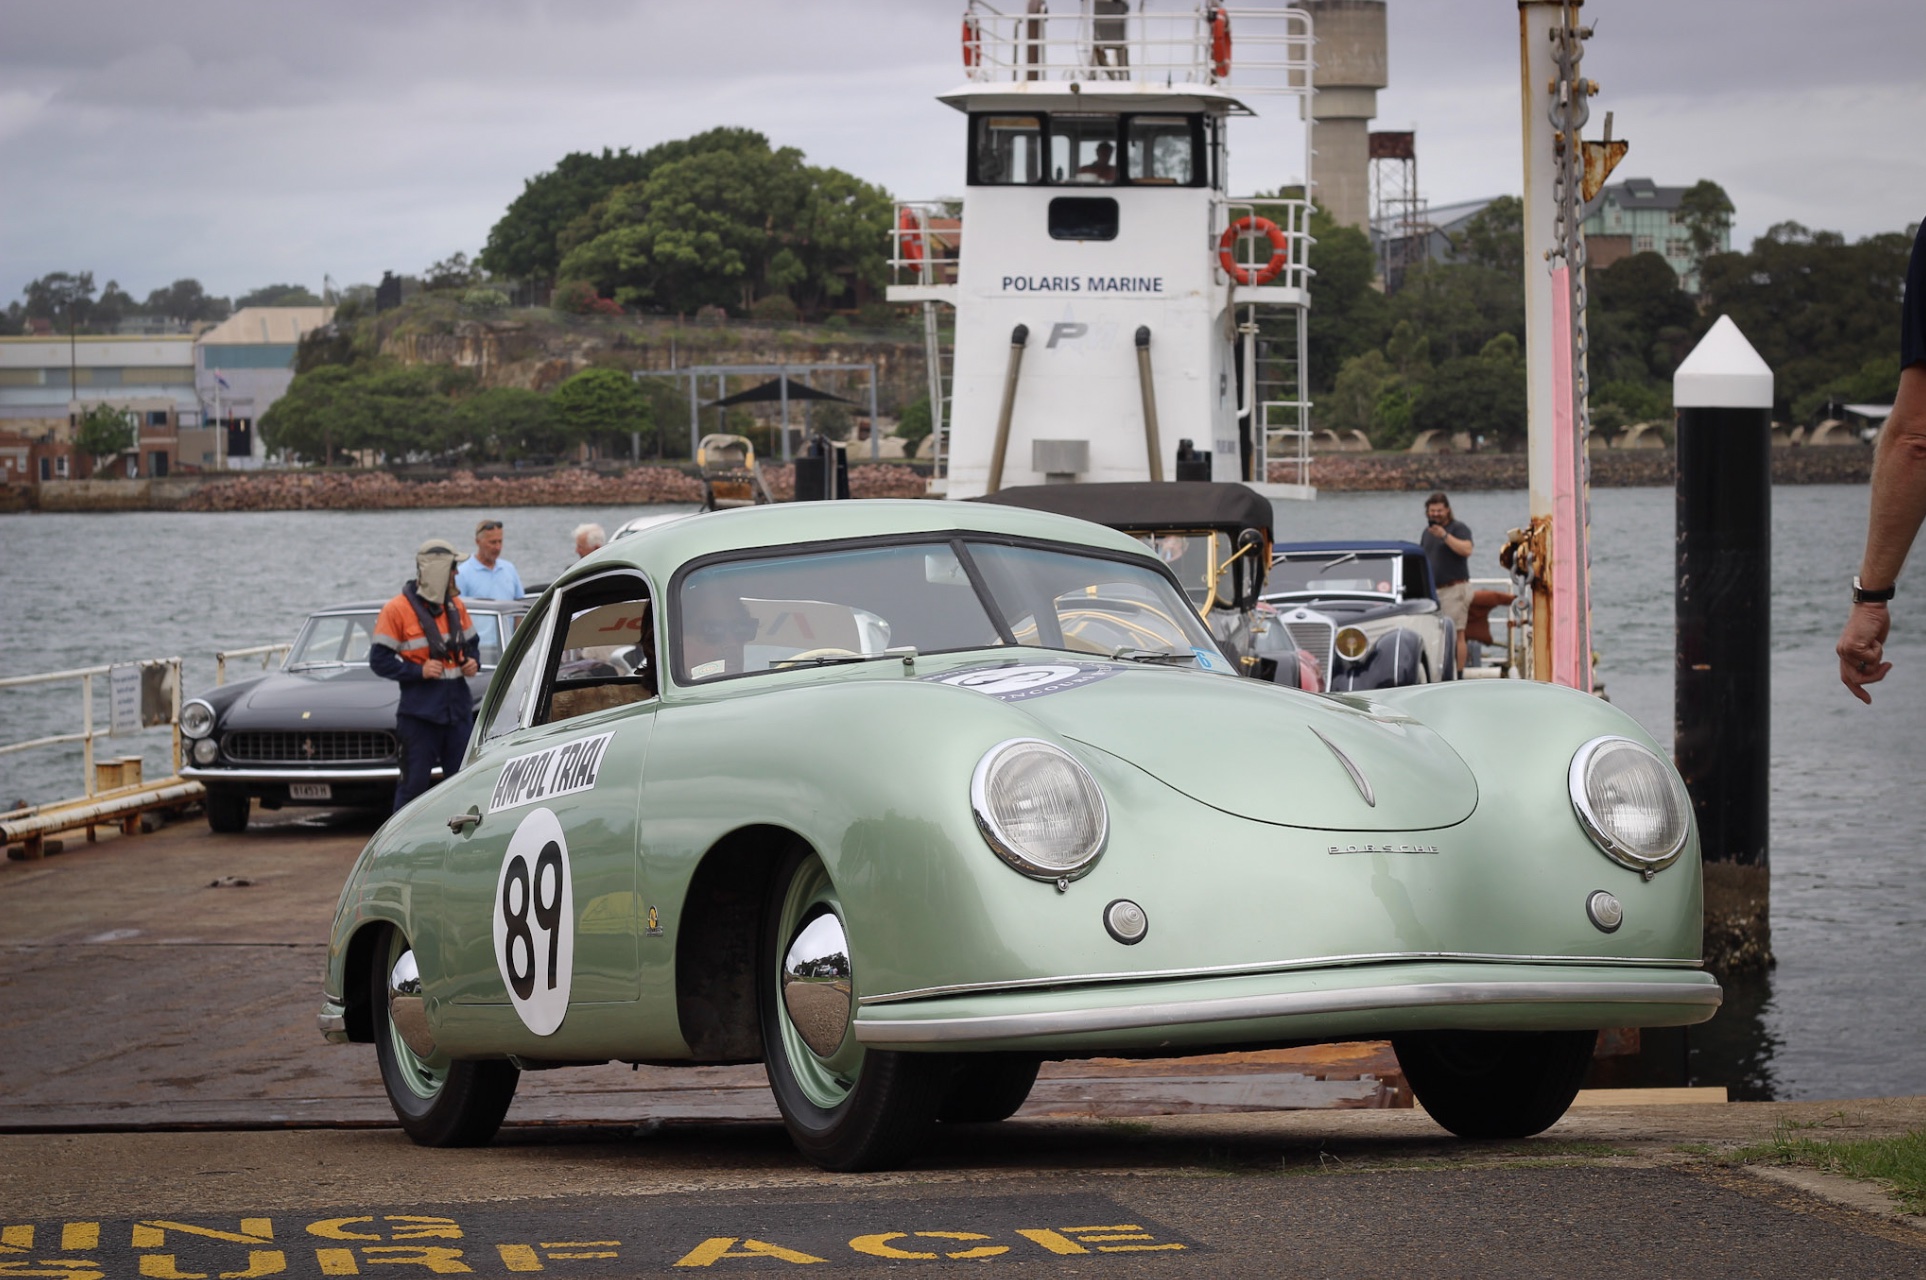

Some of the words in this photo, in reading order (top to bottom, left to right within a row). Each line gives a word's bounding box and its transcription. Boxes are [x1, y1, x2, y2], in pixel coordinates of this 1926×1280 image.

[1002, 276, 1081, 292] POLARIS
[1087, 277, 1163, 292] MARINE
[1046, 322, 1089, 349] P
[1195, 651, 1213, 668] 6
[490, 749, 557, 810] AMPOL
[549, 736, 608, 795] TRIAL
[1328, 844, 1440, 855] PORSCHE
[503, 840, 563, 1000] 89
